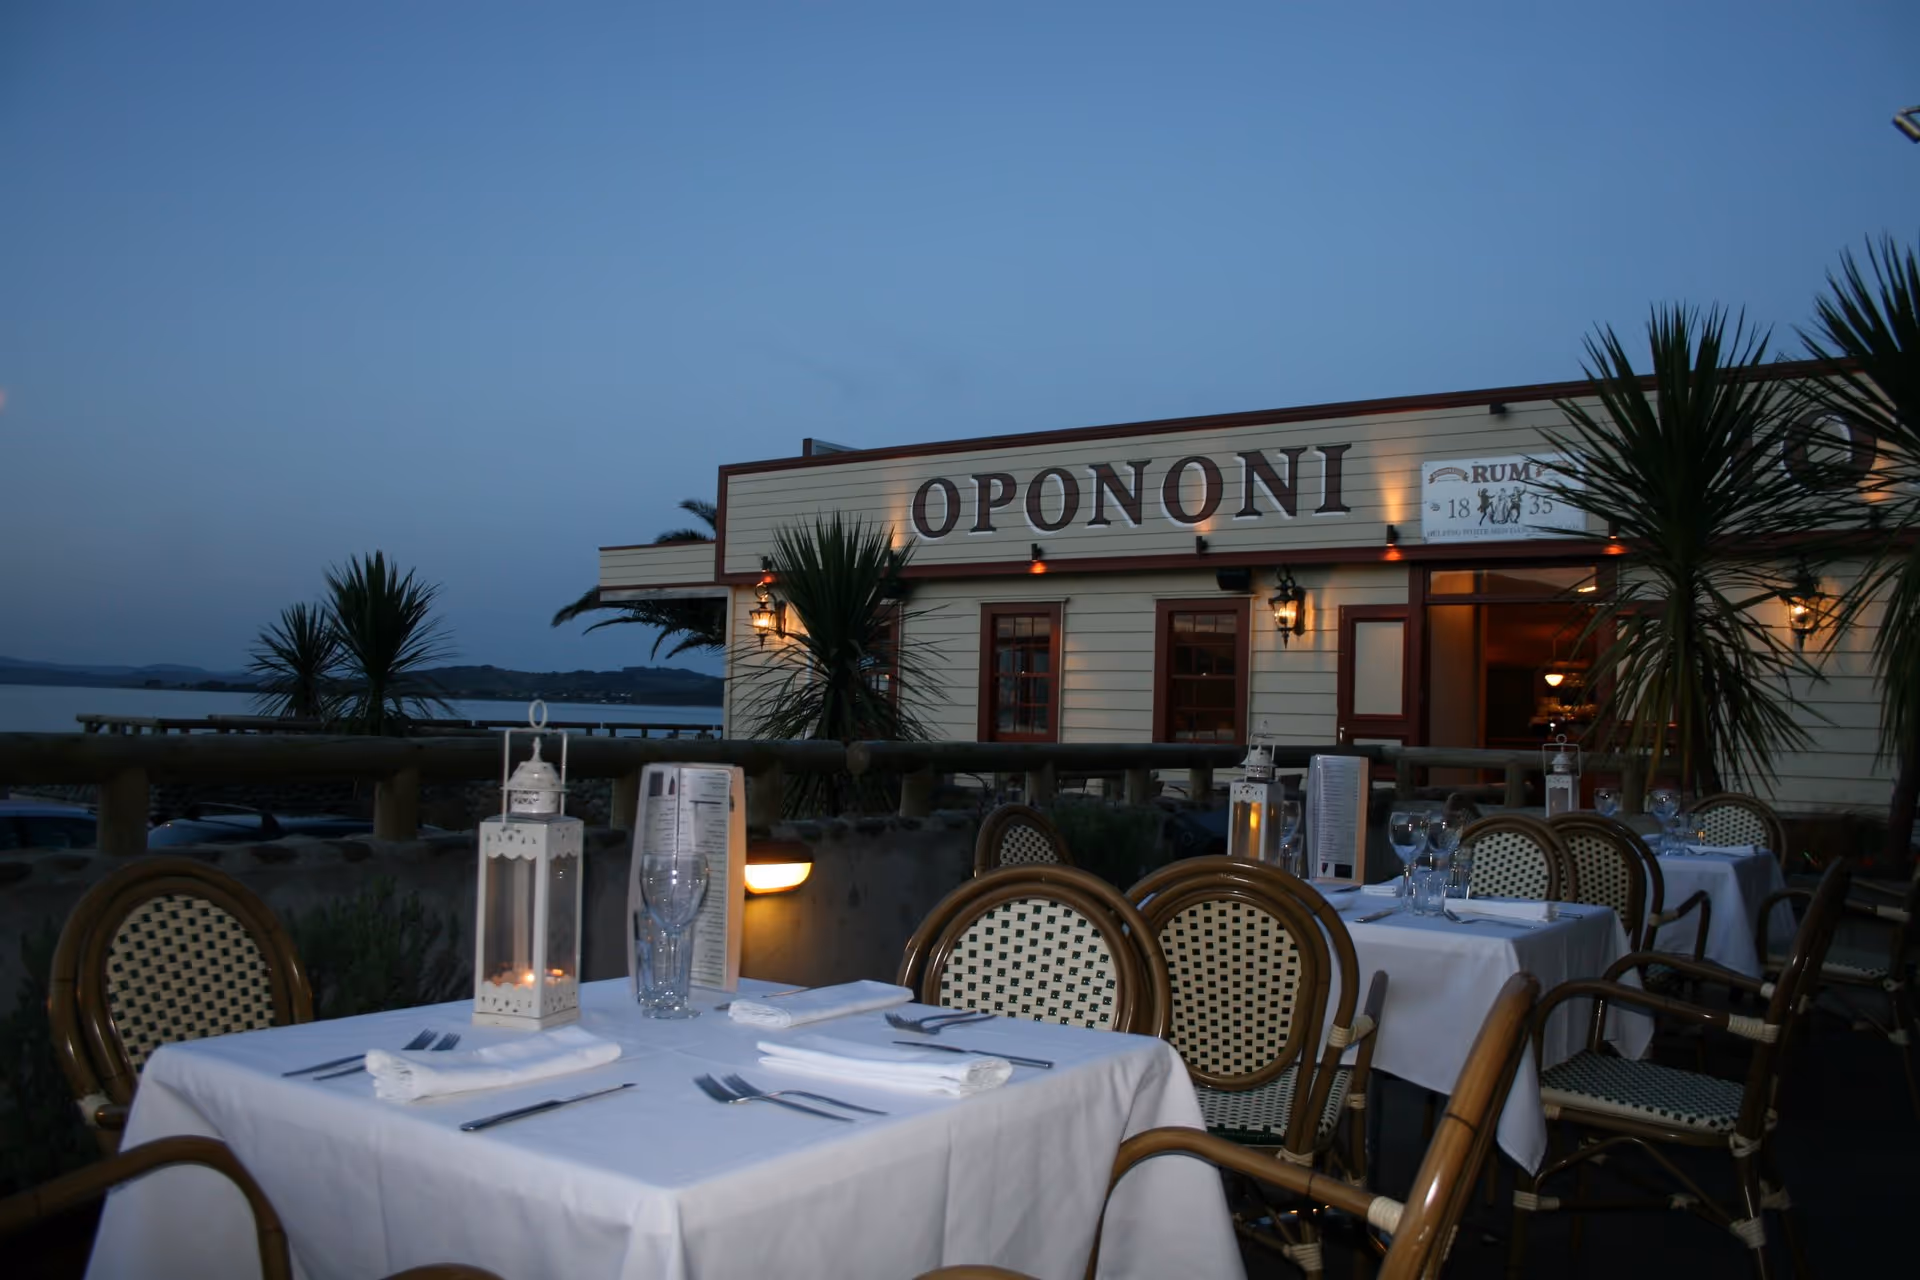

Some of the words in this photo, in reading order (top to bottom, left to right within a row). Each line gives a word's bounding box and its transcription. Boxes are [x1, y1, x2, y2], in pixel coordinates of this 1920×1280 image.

[1471, 462, 1532, 484] RUM
[911, 443, 1352, 541] OPONONI
[1448, 498, 1471, 519] 18
[1529, 494, 1553, 515] 35
